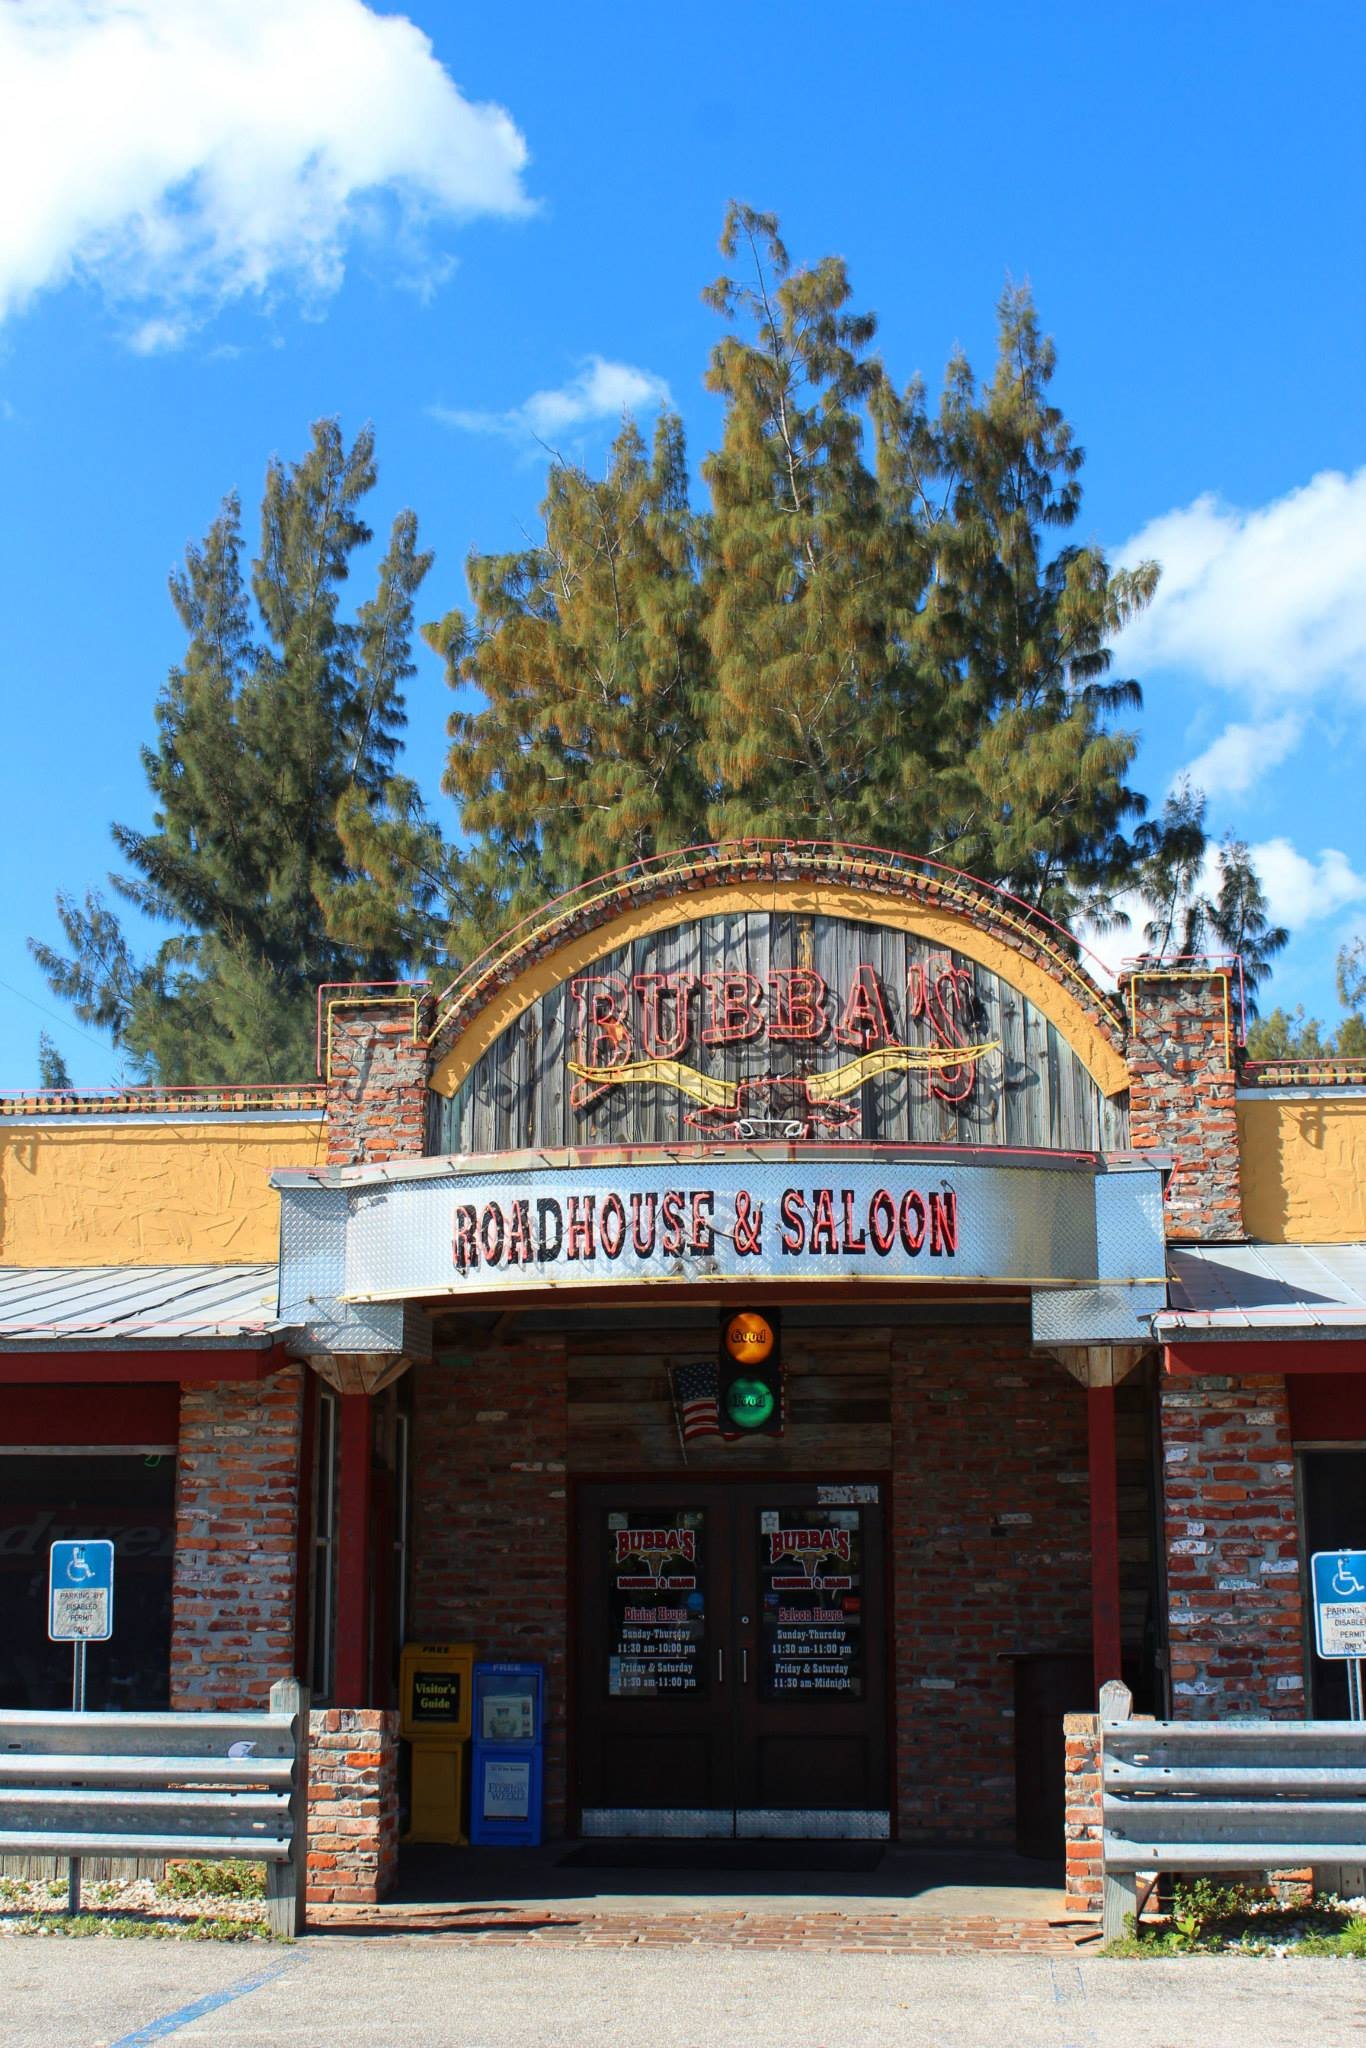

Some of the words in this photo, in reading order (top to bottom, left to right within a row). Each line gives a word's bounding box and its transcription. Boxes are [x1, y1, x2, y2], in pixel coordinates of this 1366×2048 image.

[570, 955, 976, 1106] BUBBA'S
[452, 1190, 715, 1269] ROADHOUSE
[735, 1189, 763, 1256] &
[780, 1188, 958, 1258] SALOON
[731, 1328, 767, 1344] Good
[616, 1529, 695, 1564] BUBBA'S
[770, 1528, 850, 1564] BUBBA'S
[61, 1592, 90, 1600] PARKING
[66, 1603, 98, 1611] DISABLED
[1326, 1606, 1361, 1614] PARKING
[70, 1614, 93, 1622] PERMIT
[624, 1606, 656, 1622] Dining
[657, 1606, 689, 1621] Hours
[778, 1606, 811, 1621] Saloon
[813, 1606, 844, 1621] Hours
[1334, 1618, 1366, 1626] DISABLE
[73, 1625, 90, 1633] ONLY
[622, 1629, 690, 1641] Sunday-Thursday
[1339, 1630, 1366, 1638] PERMIT
[777, 1629, 846, 1642] Sunday-Thursday
[617, 1643, 641, 1653] 11:30
[684, 1645, 696, 1654] pm
[772, 1644, 796, 1654] 11:30
[839, 1646, 852, 1656] pm
[1344, 1642, 1362, 1650] ONLY
[620, 1662, 648, 1674] Friday
[649, 1662, 656, 1672] &
[657, 1662, 693, 1674] Saturday
[775, 1663, 802, 1675] Friday
[803, 1663, 810, 1673] &
[812, 1663, 849, 1675] Saturday
[415, 1682, 457, 1694] Visitor's
[618, 1677, 641, 1687] 11:30
[684, 1679, 696, 1688] pm
[773, 1678, 797, 1688] 11:30
[799, 1677, 852, 1689] am-Midnight
[420, 1697, 451, 1709] Guide
